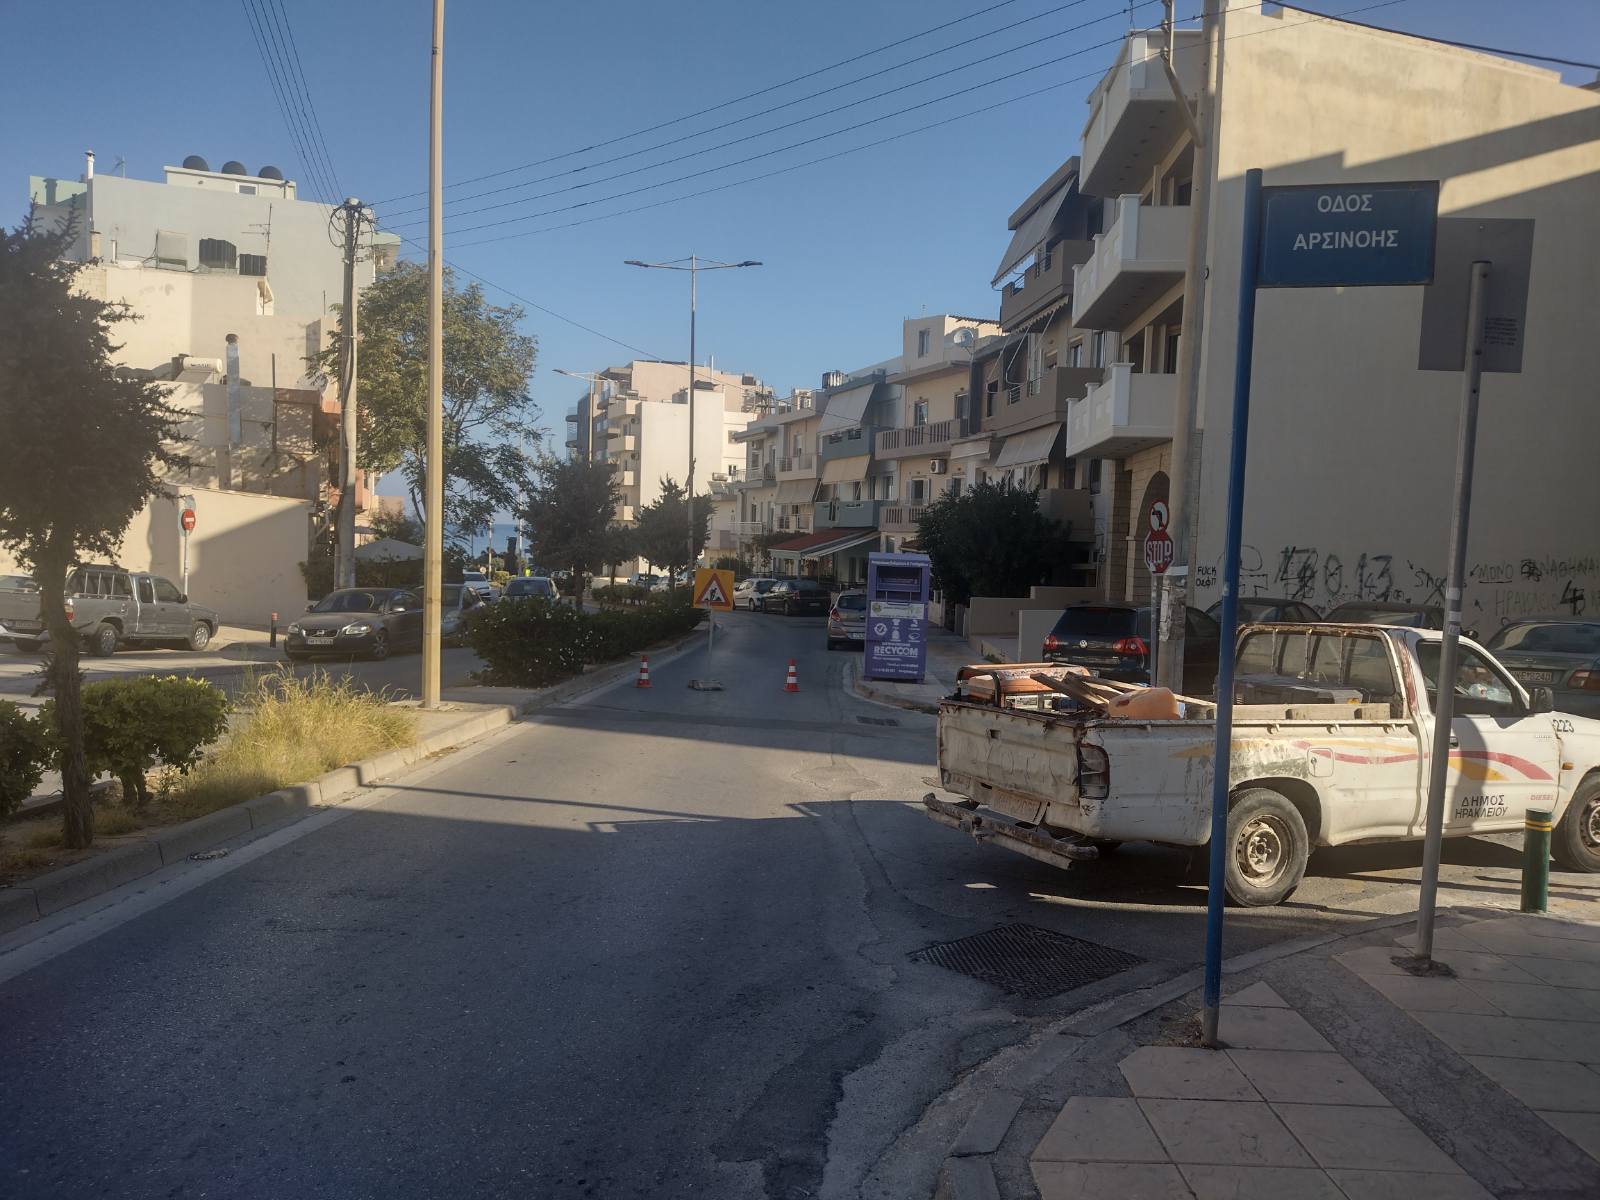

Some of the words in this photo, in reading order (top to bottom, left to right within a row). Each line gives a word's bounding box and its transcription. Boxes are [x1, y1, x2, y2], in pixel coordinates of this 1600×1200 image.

[1317, 194, 1373, 212] ΟΔΟΣ
[1293, 229, 1399, 250] ΑΡΣΙΝΟΗΣ
[1147, 540, 1172, 563] STOP
[1197, 566, 1217, 576] FUCK
[873, 646, 918, 656] RECYCOM
[1461, 795, 1505, 807] ΔΗΜΟΣ
[1455, 806, 1508, 819] ΗΡΑΚΛΕΙΟΥ
